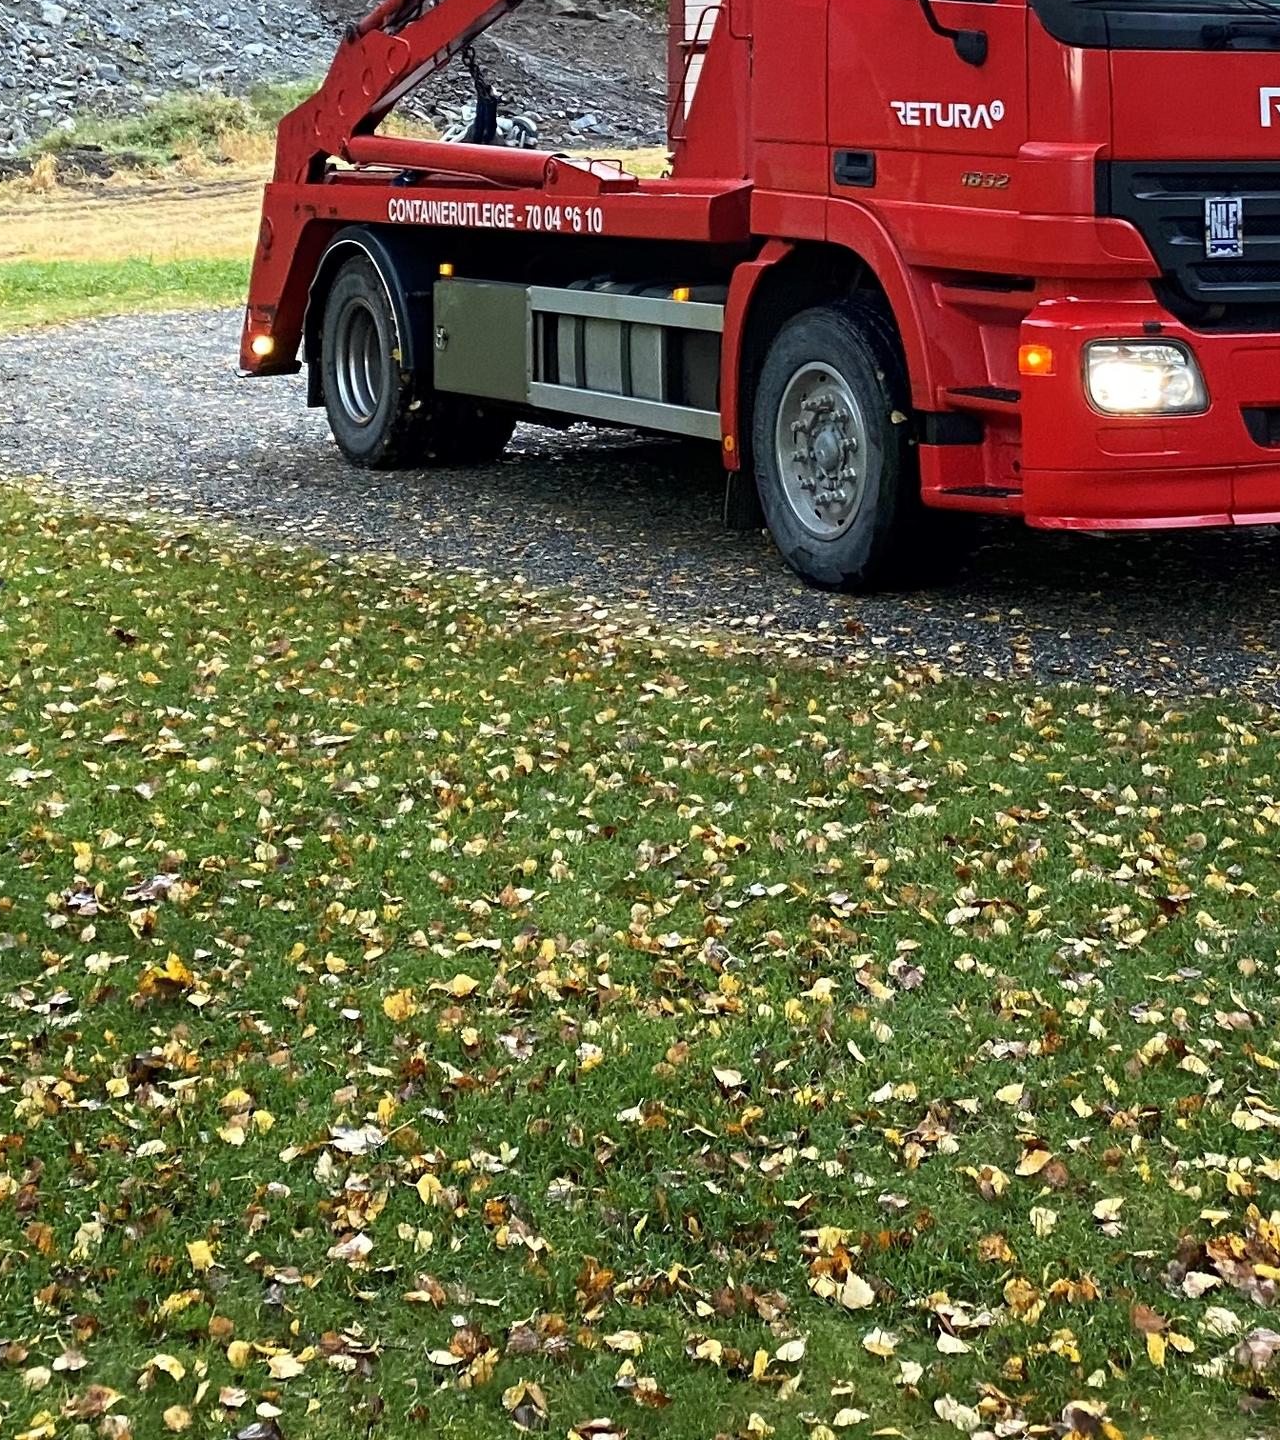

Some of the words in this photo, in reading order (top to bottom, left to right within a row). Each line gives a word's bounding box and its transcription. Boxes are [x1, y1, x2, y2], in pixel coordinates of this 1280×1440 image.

[889, 101, 993, 130] RETURA
[388, 198, 515, 228] CONTAINERUTLEIGE
[525, 205, 541, 230] 70
[544, 205, 562, 230] 04
[585, 207, 603, 233] 10
